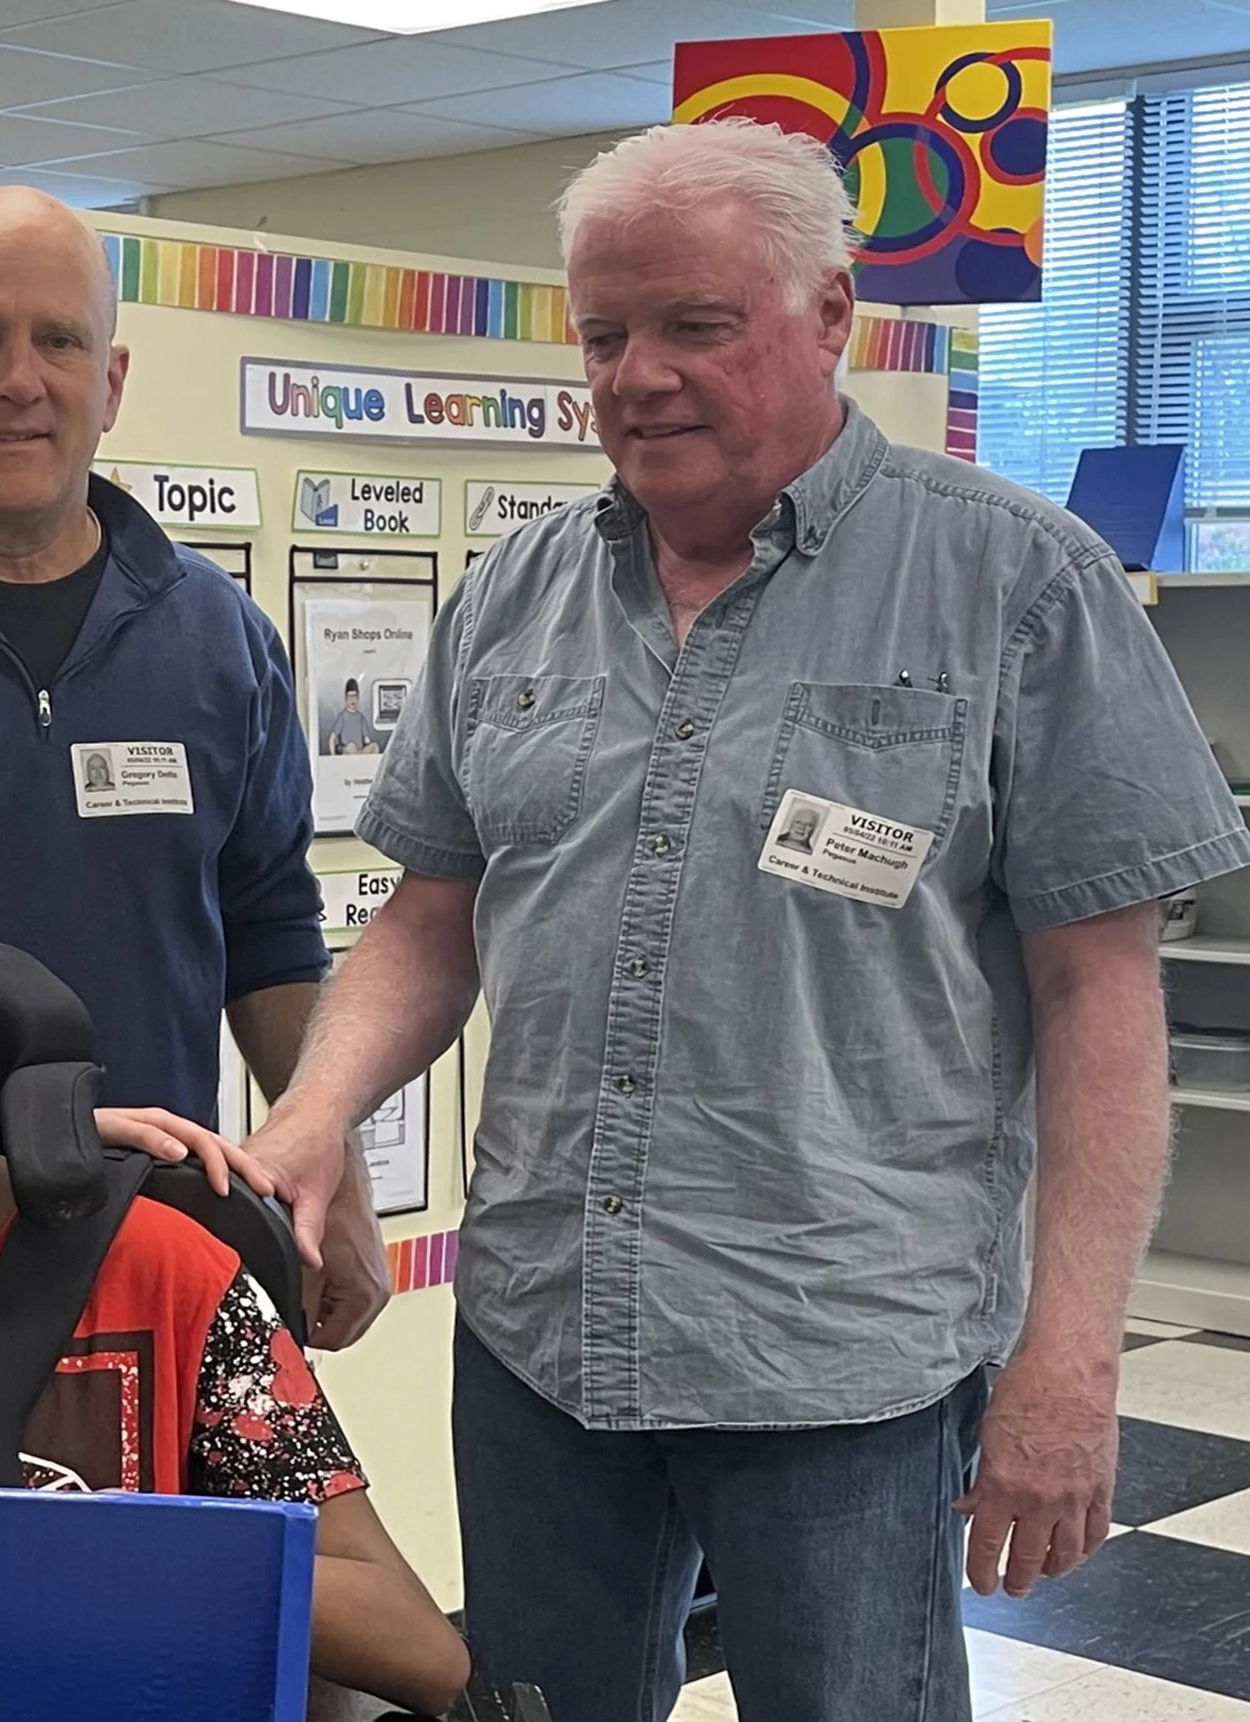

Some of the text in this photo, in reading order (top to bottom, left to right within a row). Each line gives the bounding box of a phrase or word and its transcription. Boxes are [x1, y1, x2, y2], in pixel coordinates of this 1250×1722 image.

[268, 371, 386, 430] Unique
[404, 382, 546, 439] Learning
[153, 474, 237, 521] Topic
[351, 478, 424, 504] Leveled
[498, 494, 568, 519] Stand
[364, 511, 410, 534] Book
[324, 628, 413, 643] Ryan Shops Online
[127, 746, 175, 756] VISITOR
[121, 770, 156, 780] Gregory
[850, 814, 914, 843] VISITOR
[826, 837, 909, 871] Peter Machugh
[900, 842, 914, 852] AM
[768, 854, 899, 899] Career & Technical Institute
